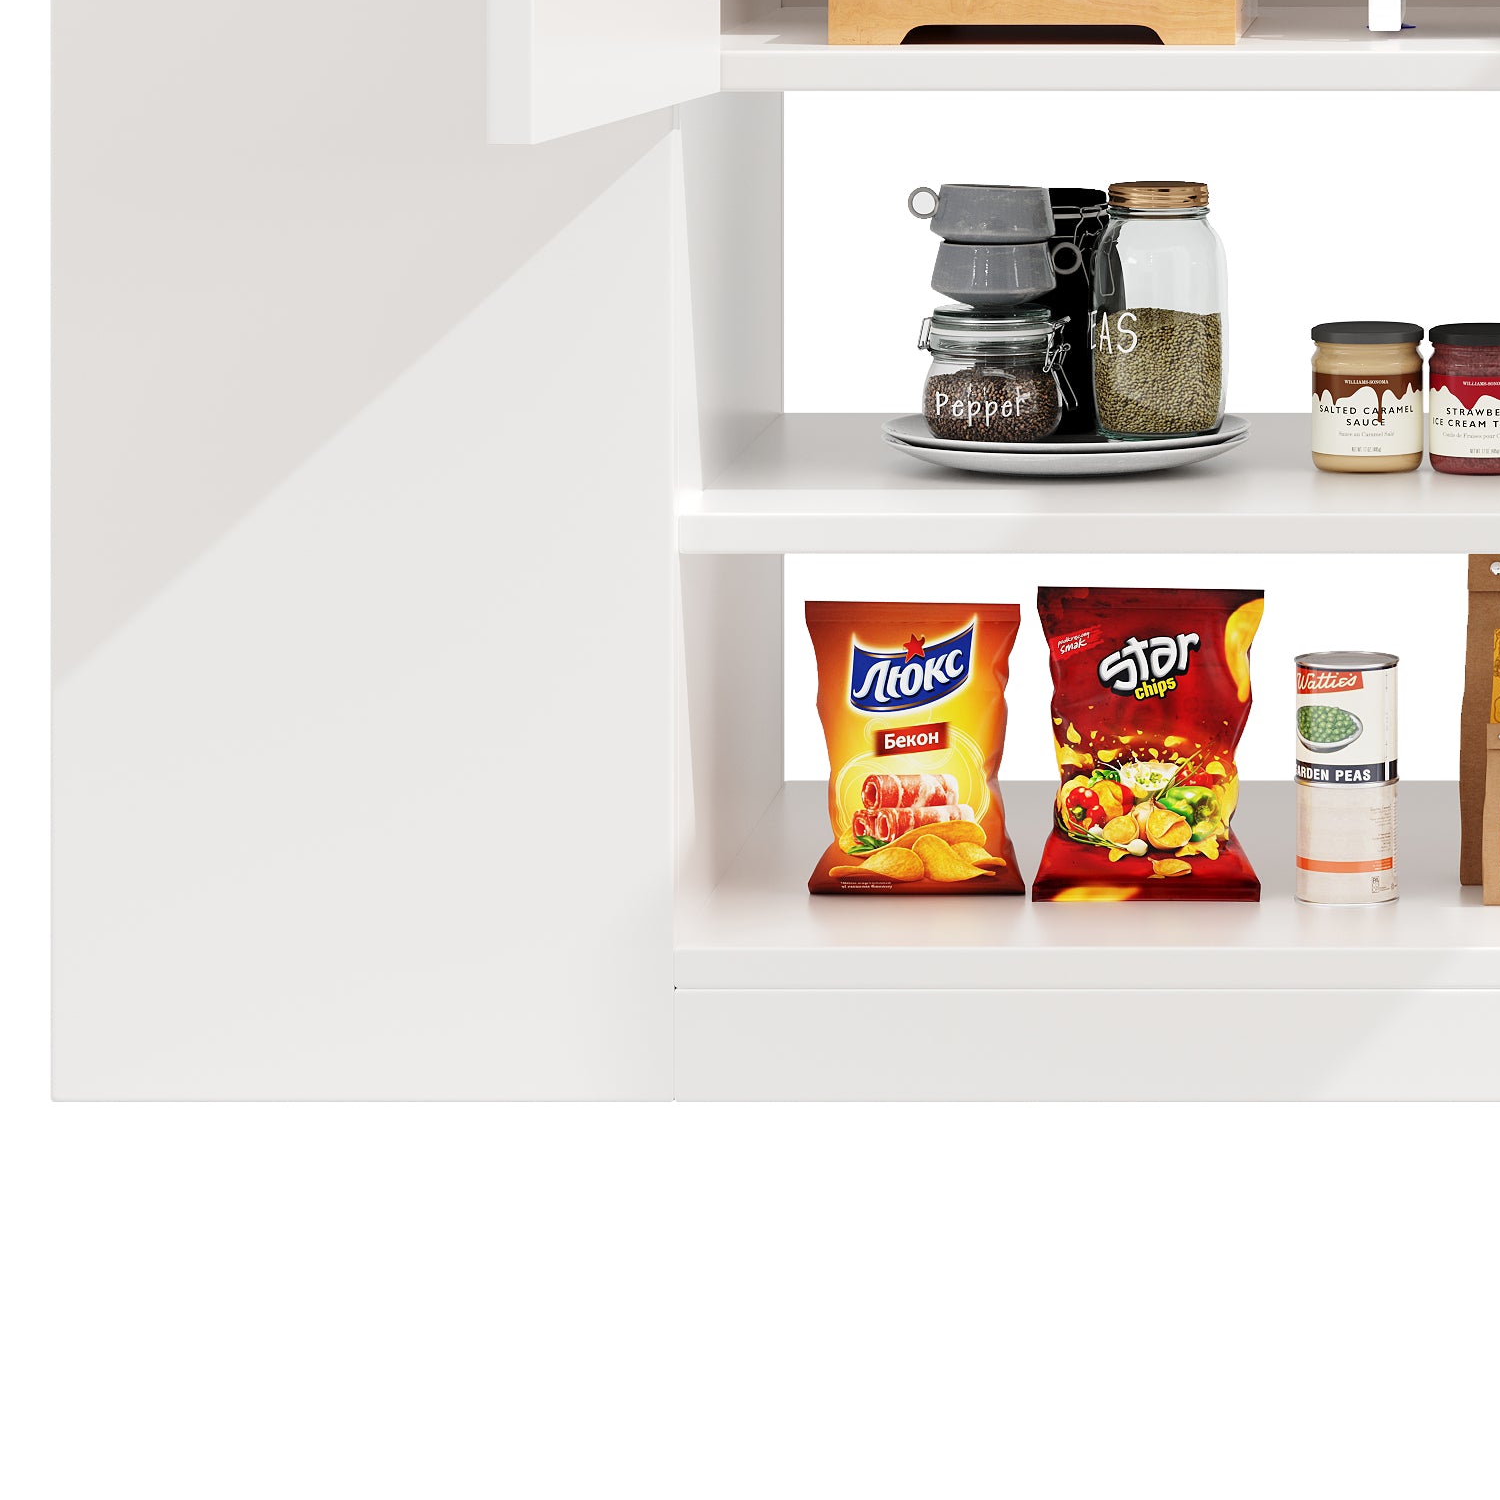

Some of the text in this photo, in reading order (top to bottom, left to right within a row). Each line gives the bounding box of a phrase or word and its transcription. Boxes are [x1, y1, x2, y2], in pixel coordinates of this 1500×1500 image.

[936, 386, 1031, 427] Pepper
[1320, 405, 1413, 414] SALTED CARAMEL
[1060, 638, 1087, 654] smak
[853, 649, 965, 702] Люкс
[1134, 677, 1176, 700] chips
[884, 730, 939, 750] Бекон
[1296, 765, 1371, 781] ARDEN PEAS
